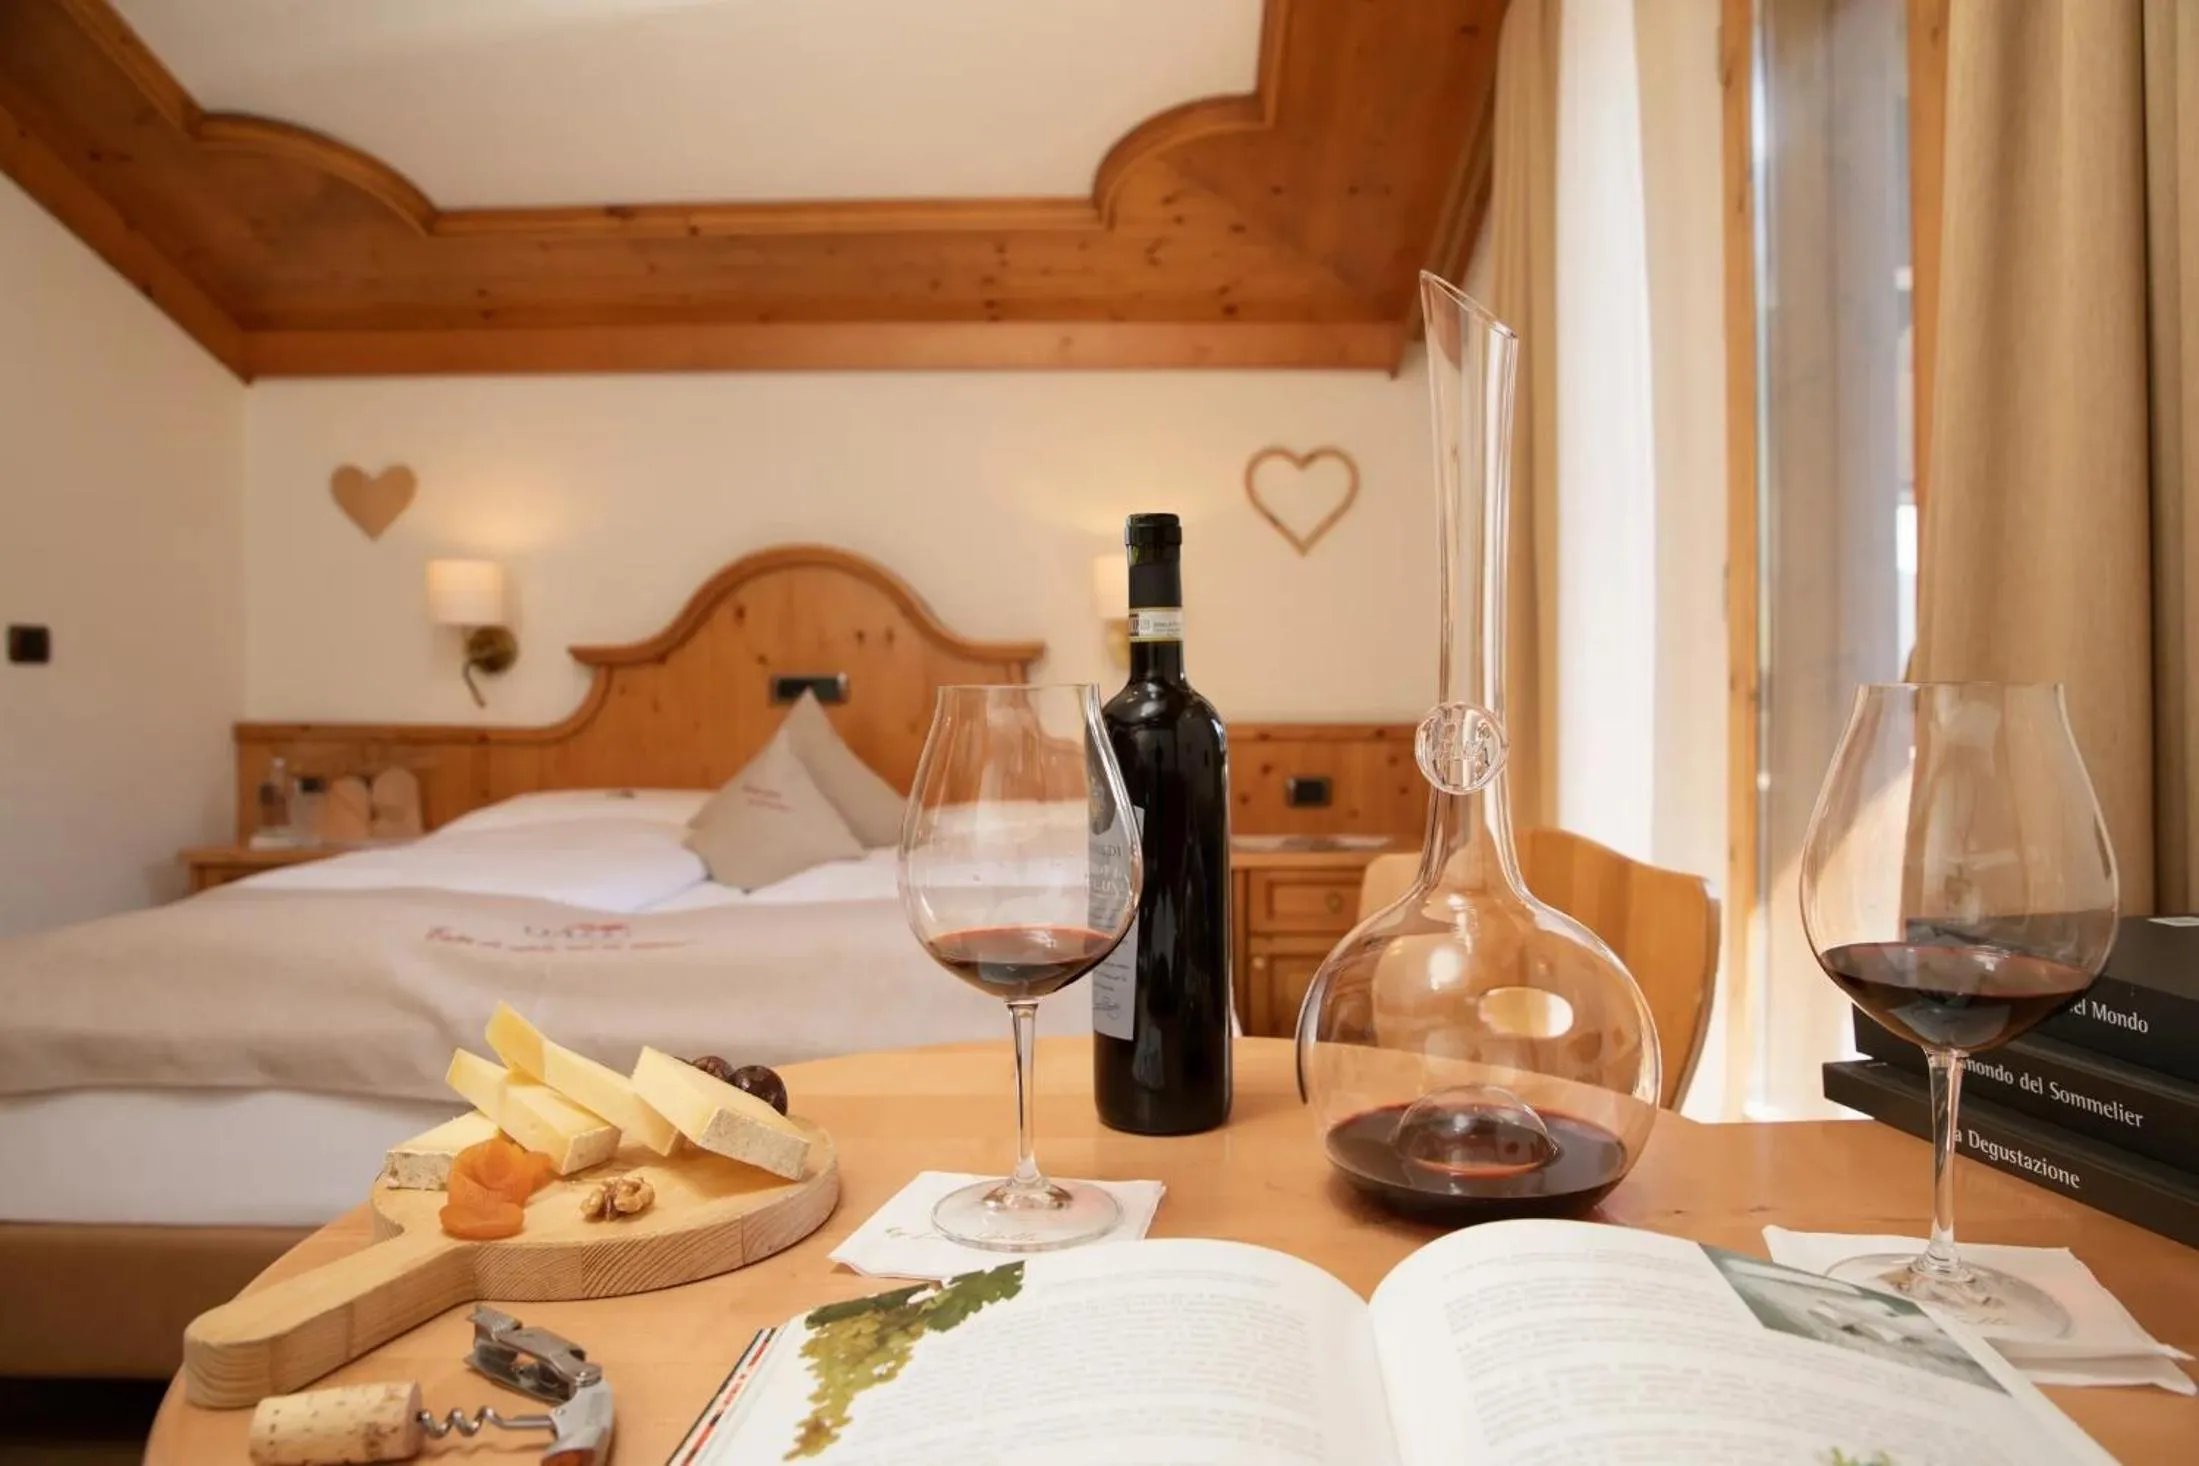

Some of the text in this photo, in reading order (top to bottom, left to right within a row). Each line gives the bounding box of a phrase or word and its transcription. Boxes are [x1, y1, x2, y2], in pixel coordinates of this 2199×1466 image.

[2069, 998, 2149, 1034] el Mondo
[2019, 1073, 2043, 1095] del
[2049, 1081, 2144, 1128] Sommelier
[1968, 1129, 2081, 1188] Degustazione
